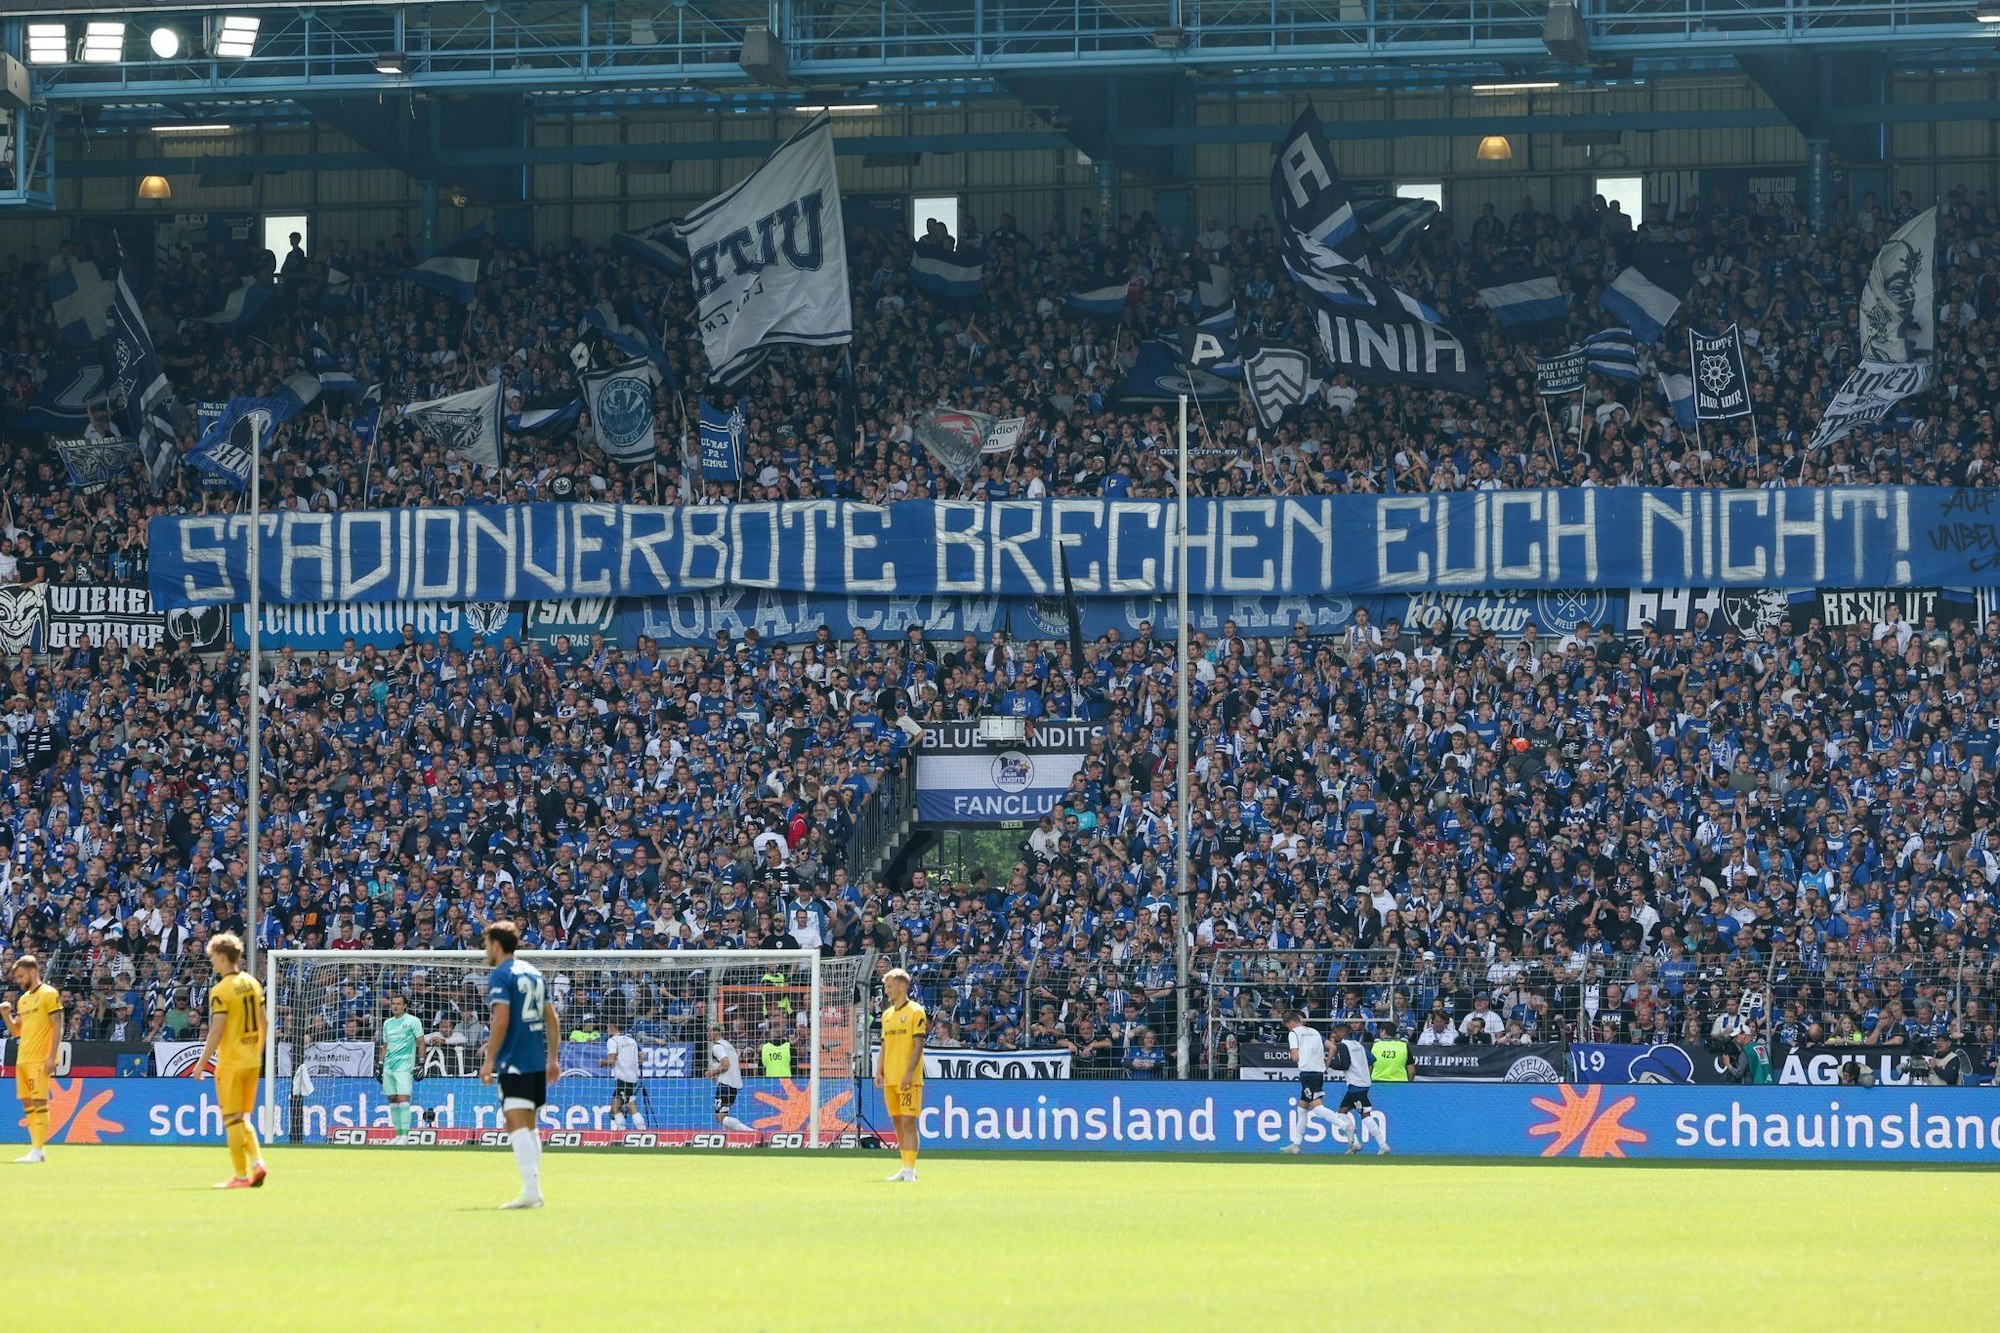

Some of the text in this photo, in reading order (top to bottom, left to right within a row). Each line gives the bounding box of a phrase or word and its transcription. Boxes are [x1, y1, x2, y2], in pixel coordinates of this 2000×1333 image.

[1546, 376, 1580, 389] SIEGER
[1722, 389, 1743, 409] WIR
[179, 488, 1912, 601] STADIONVERBOTE BRECHEN EUCH NICHT!
[50, 622, 165, 649] GEBIRGE
[242, 994, 259, 1034] 11
[768, 1052, 783, 1062] 106
[1381, 1050, 1397, 1060] 423
[1434, 1056, 1480, 1068] LIPPER
[1578, 1050, 1606, 1074] 19
[901, 1093, 912, 1107] 28
[919, 1094, 1216, 1141] chauinsland
[549, 1132, 582, 1147] SO
[624, 1133, 658, 1148] SO
[692, 1133, 726, 1148] SO
[769, 1133, 804, 1149] SO
